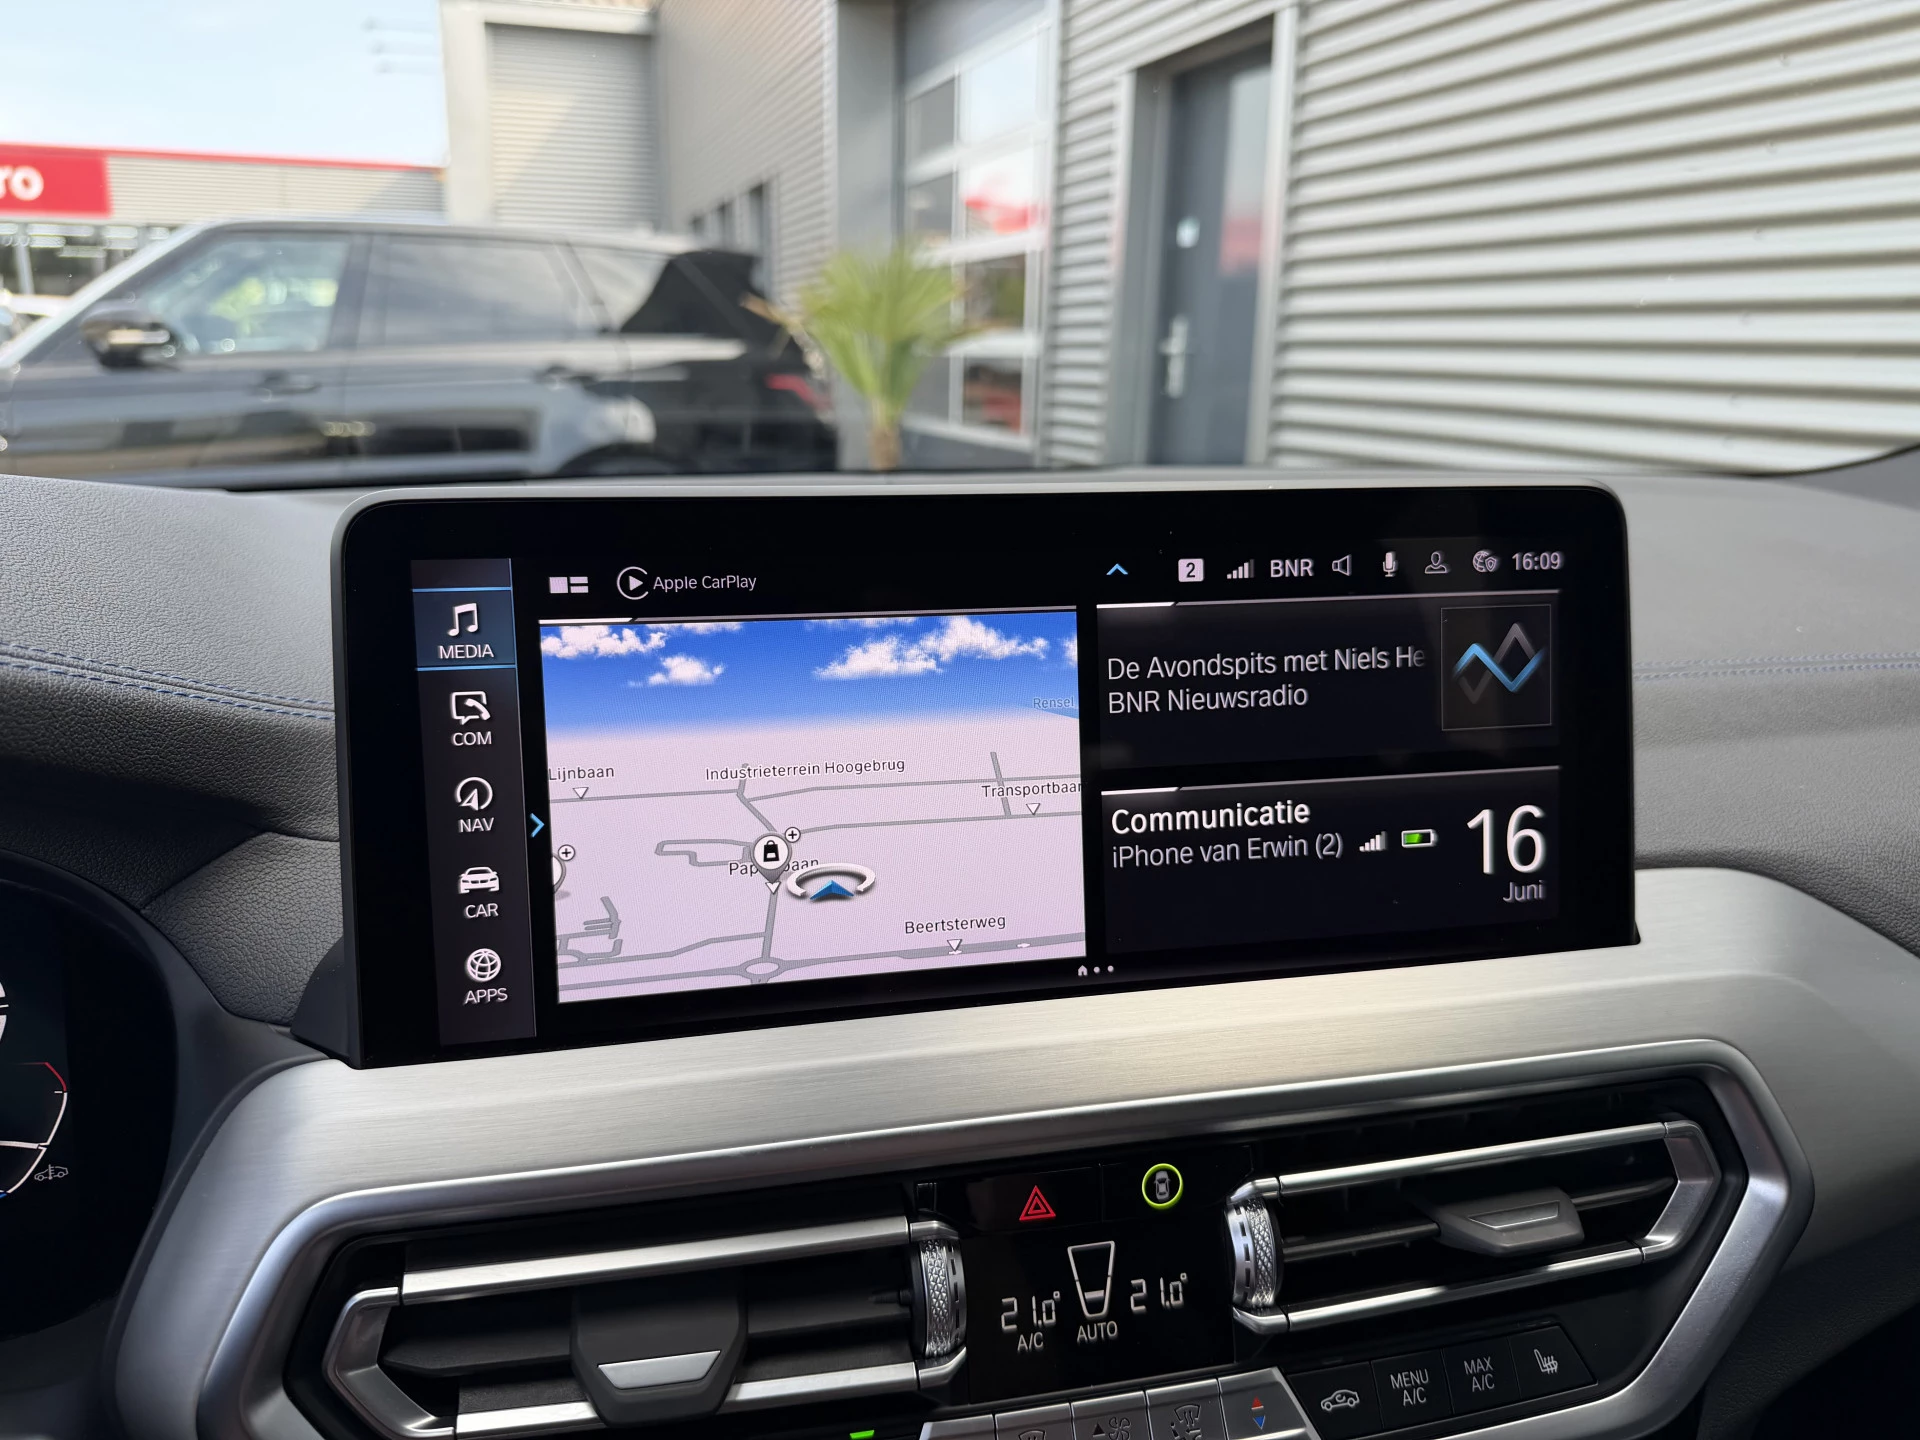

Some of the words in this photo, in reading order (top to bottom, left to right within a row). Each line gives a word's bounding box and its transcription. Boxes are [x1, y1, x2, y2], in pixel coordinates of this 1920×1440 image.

[1270, 558, 1314, 578] BNR
[1512, 552, 1563, 571] 16:09
[653, 575, 697, 592] Apple
[701, 573, 757, 592] CarPlay
[438, 644, 494, 660] MEDIA
[1107, 657, 1140, 680] De
[1146, 653, 1276, 678] Avondspits
[1284, 651, 1328, 672] met
[1334, 647, 1388, 671] Niels
[1396, 644, 1425, 667] He
[1033, 697, 1075, 708] Rensel
[1108, 691, 1161, 713] BNR
[1168, 685, 1308, 711] Nieuwsradio
[452, 731, 492, 746] COM
[549, 767, 615, 782] Lijnbaan
[705, 763, 820, 781] Industrieterrein
[825, 759, 906, 774] Hoogebrug
[459, 817, 494, 833] NAV
[1112, 800, 1310, 834] Communicatie
[1467, 805, 1546, 874] 16
[1113, 840, 1194, 868] iPhone
[1200, 842, 1240, 862] van
[1248, 836, 1309, 859] Erwin
[1315, 832, 1344, 859] (2)
[1503, 880, 1544, 903] Juni
[465, 902, 498, 918] CAR
[905, 915, 1006, 934] Beertsterweg
[464, 987, 508, 1005] APPS
[1077, 1321, 1118, 1342] AUTO
[1017, 1332, 1044, 1352] A/C
[1464, 1357, 1493, 1375] MAX
[1390, 1369, 1429, 1389] MENU
[1472, 1374, 1495, 1392] A/C
[1403, 1387, 1427, 1407] A/C
